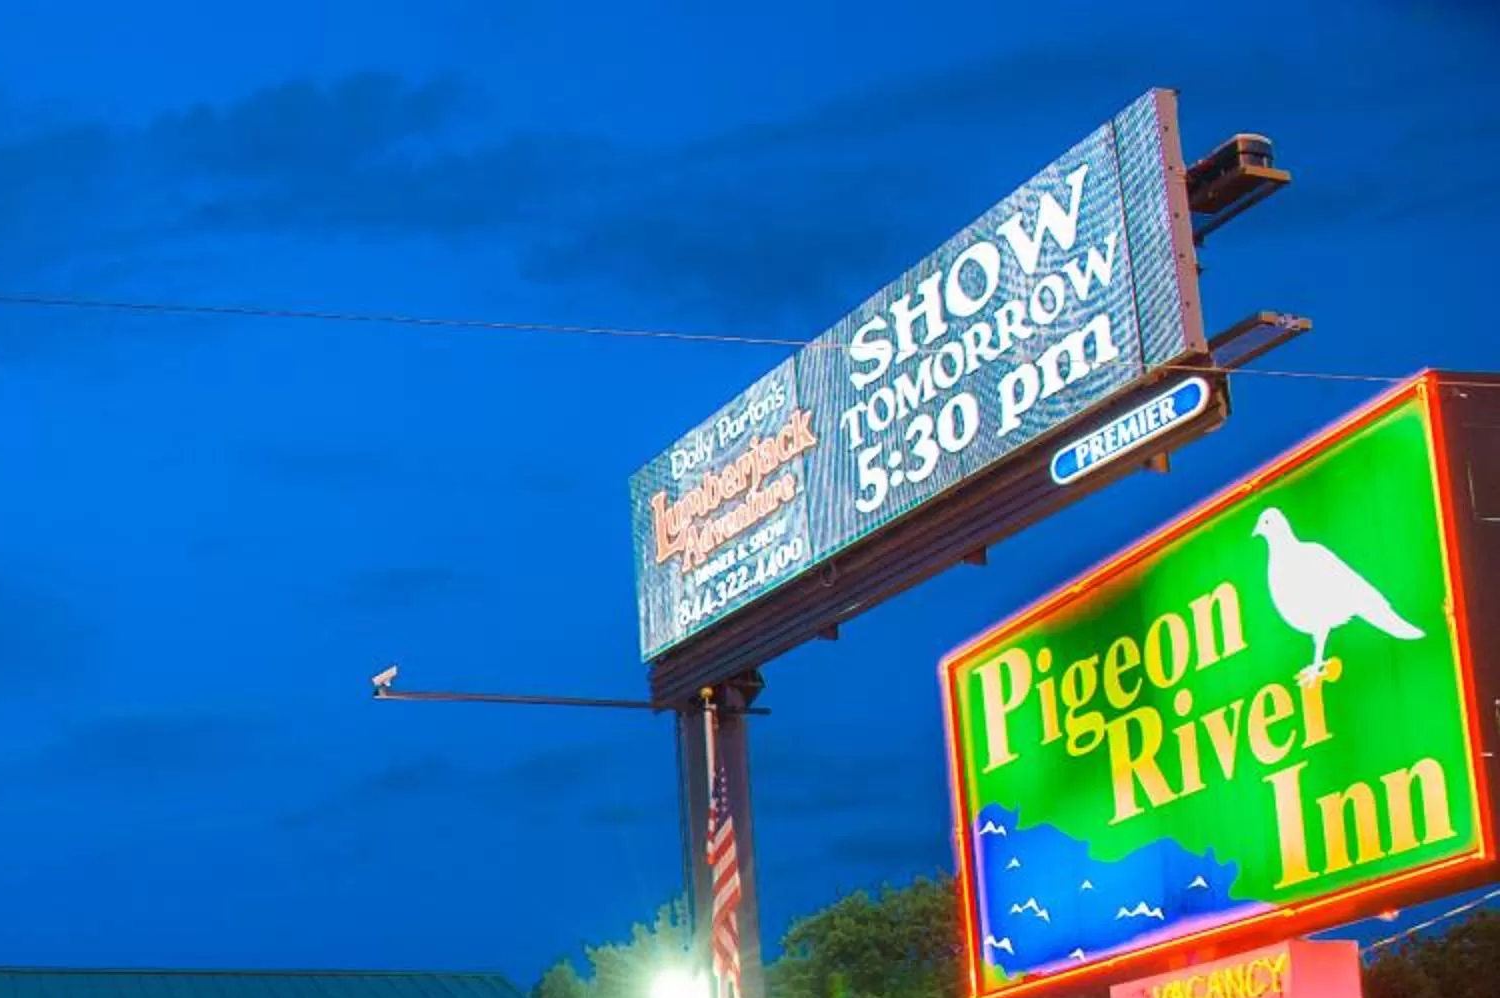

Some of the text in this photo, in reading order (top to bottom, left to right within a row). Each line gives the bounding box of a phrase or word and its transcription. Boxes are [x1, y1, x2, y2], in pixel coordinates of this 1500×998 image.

[840, 234, 1117, 451] TOMORROW
[849, 163, 1089, 391] SHOW
[651, 409, 817, 563] Lumberjack
[670, 381, 786, 480] Dolly Parton's
[854, 313, 1119, 513] 5:30 pm
[1075, 396, 1178, 469] PREMIER
[973, 580, 1248, 775] Pigeon
[1102, 657, 1343, 826] River
[1263, 756, 1457, 889] Inn
